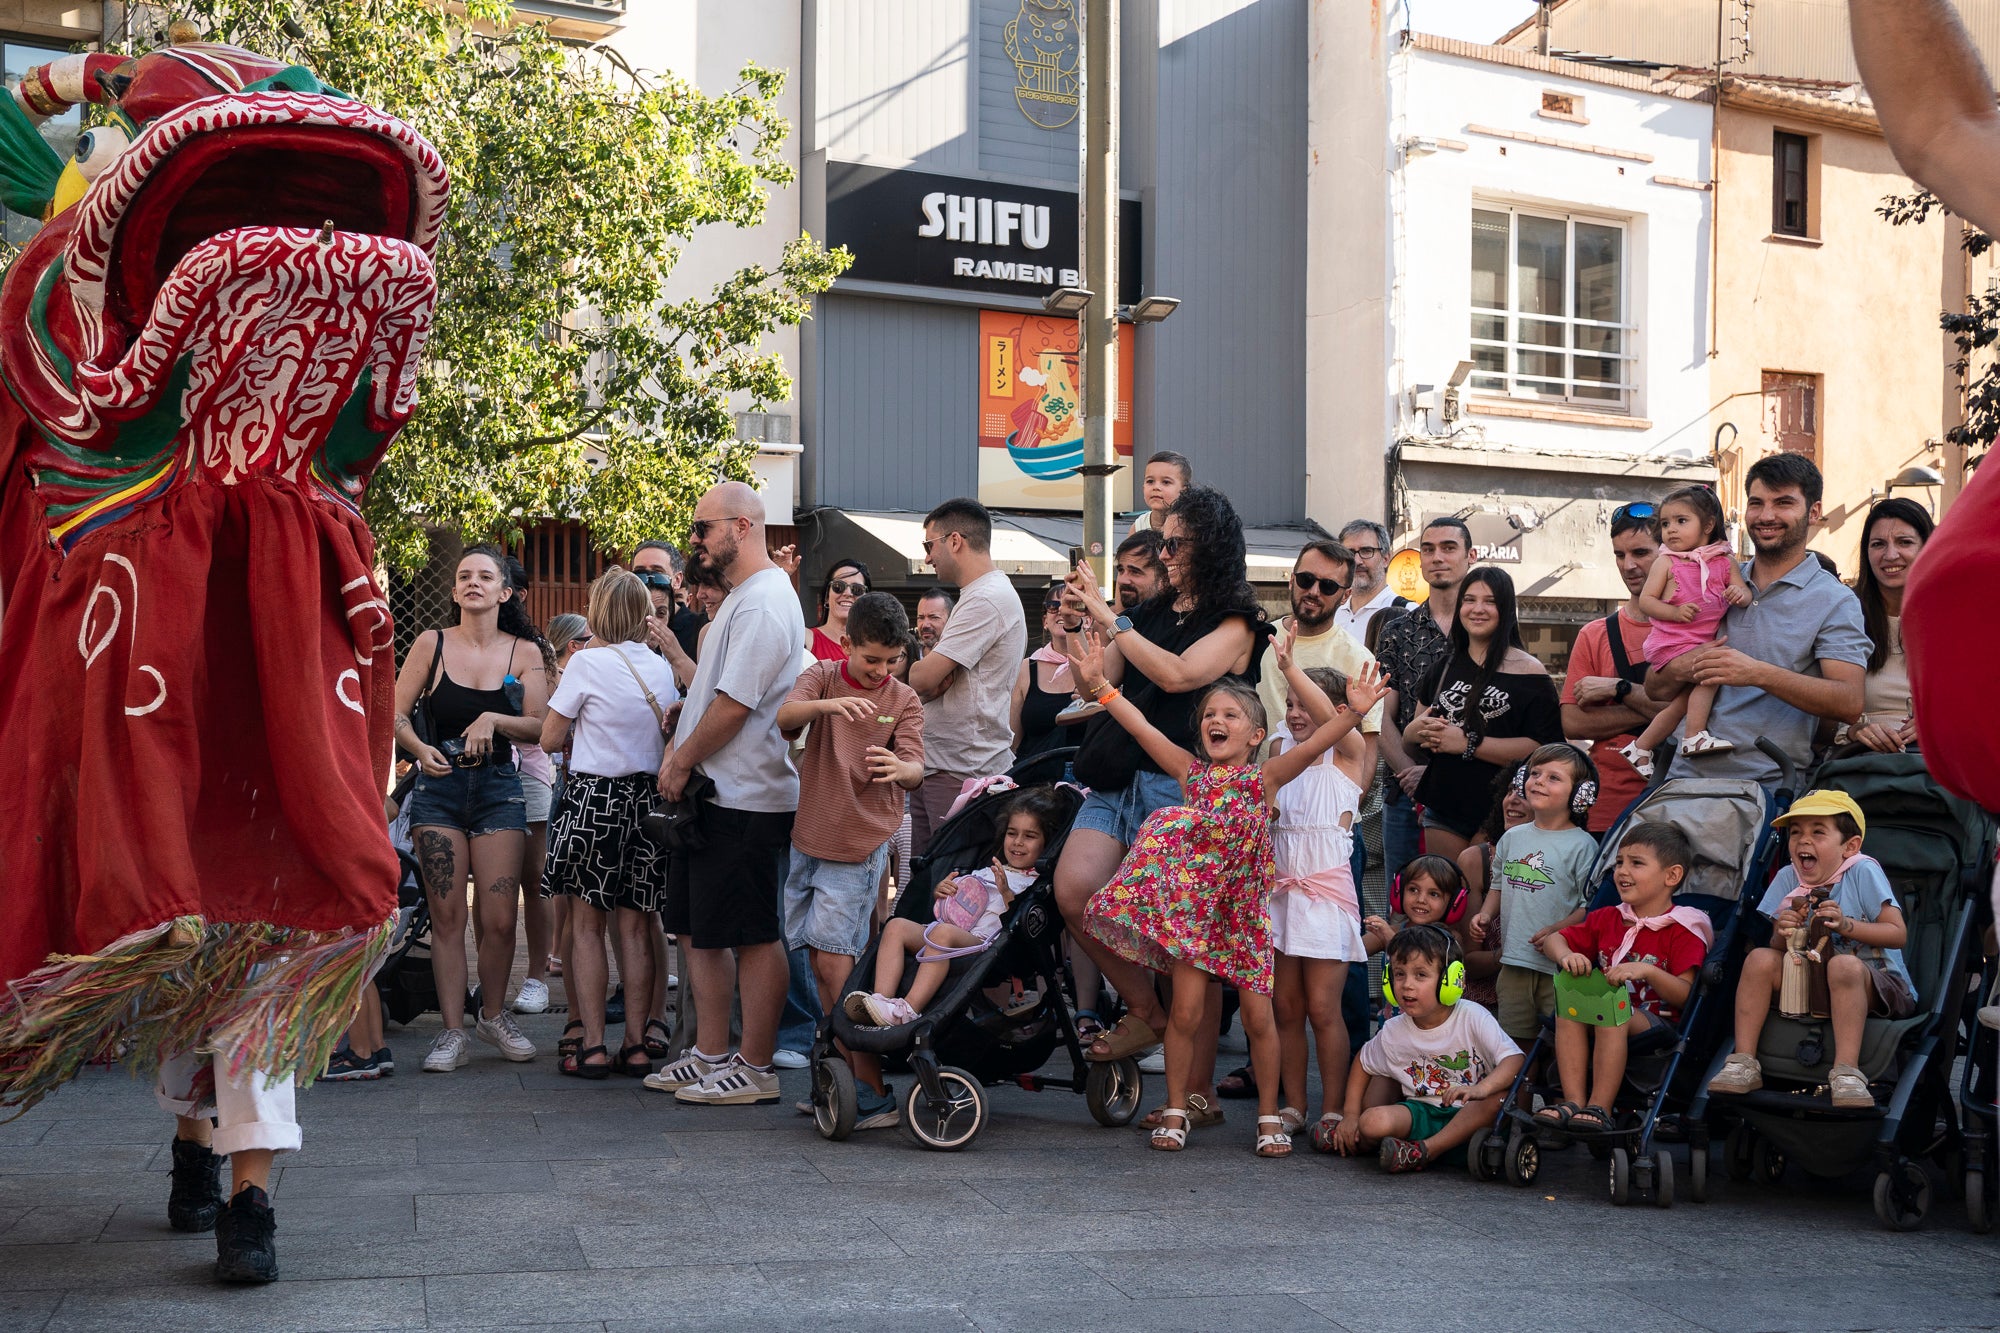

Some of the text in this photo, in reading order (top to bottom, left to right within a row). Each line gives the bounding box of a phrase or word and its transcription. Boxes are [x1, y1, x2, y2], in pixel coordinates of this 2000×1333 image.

[918, 192, 1050, 249] SHIFU
[954, 257, 1053, 284] RAMEN
[997, 341, 1007, 390] ラーメン
